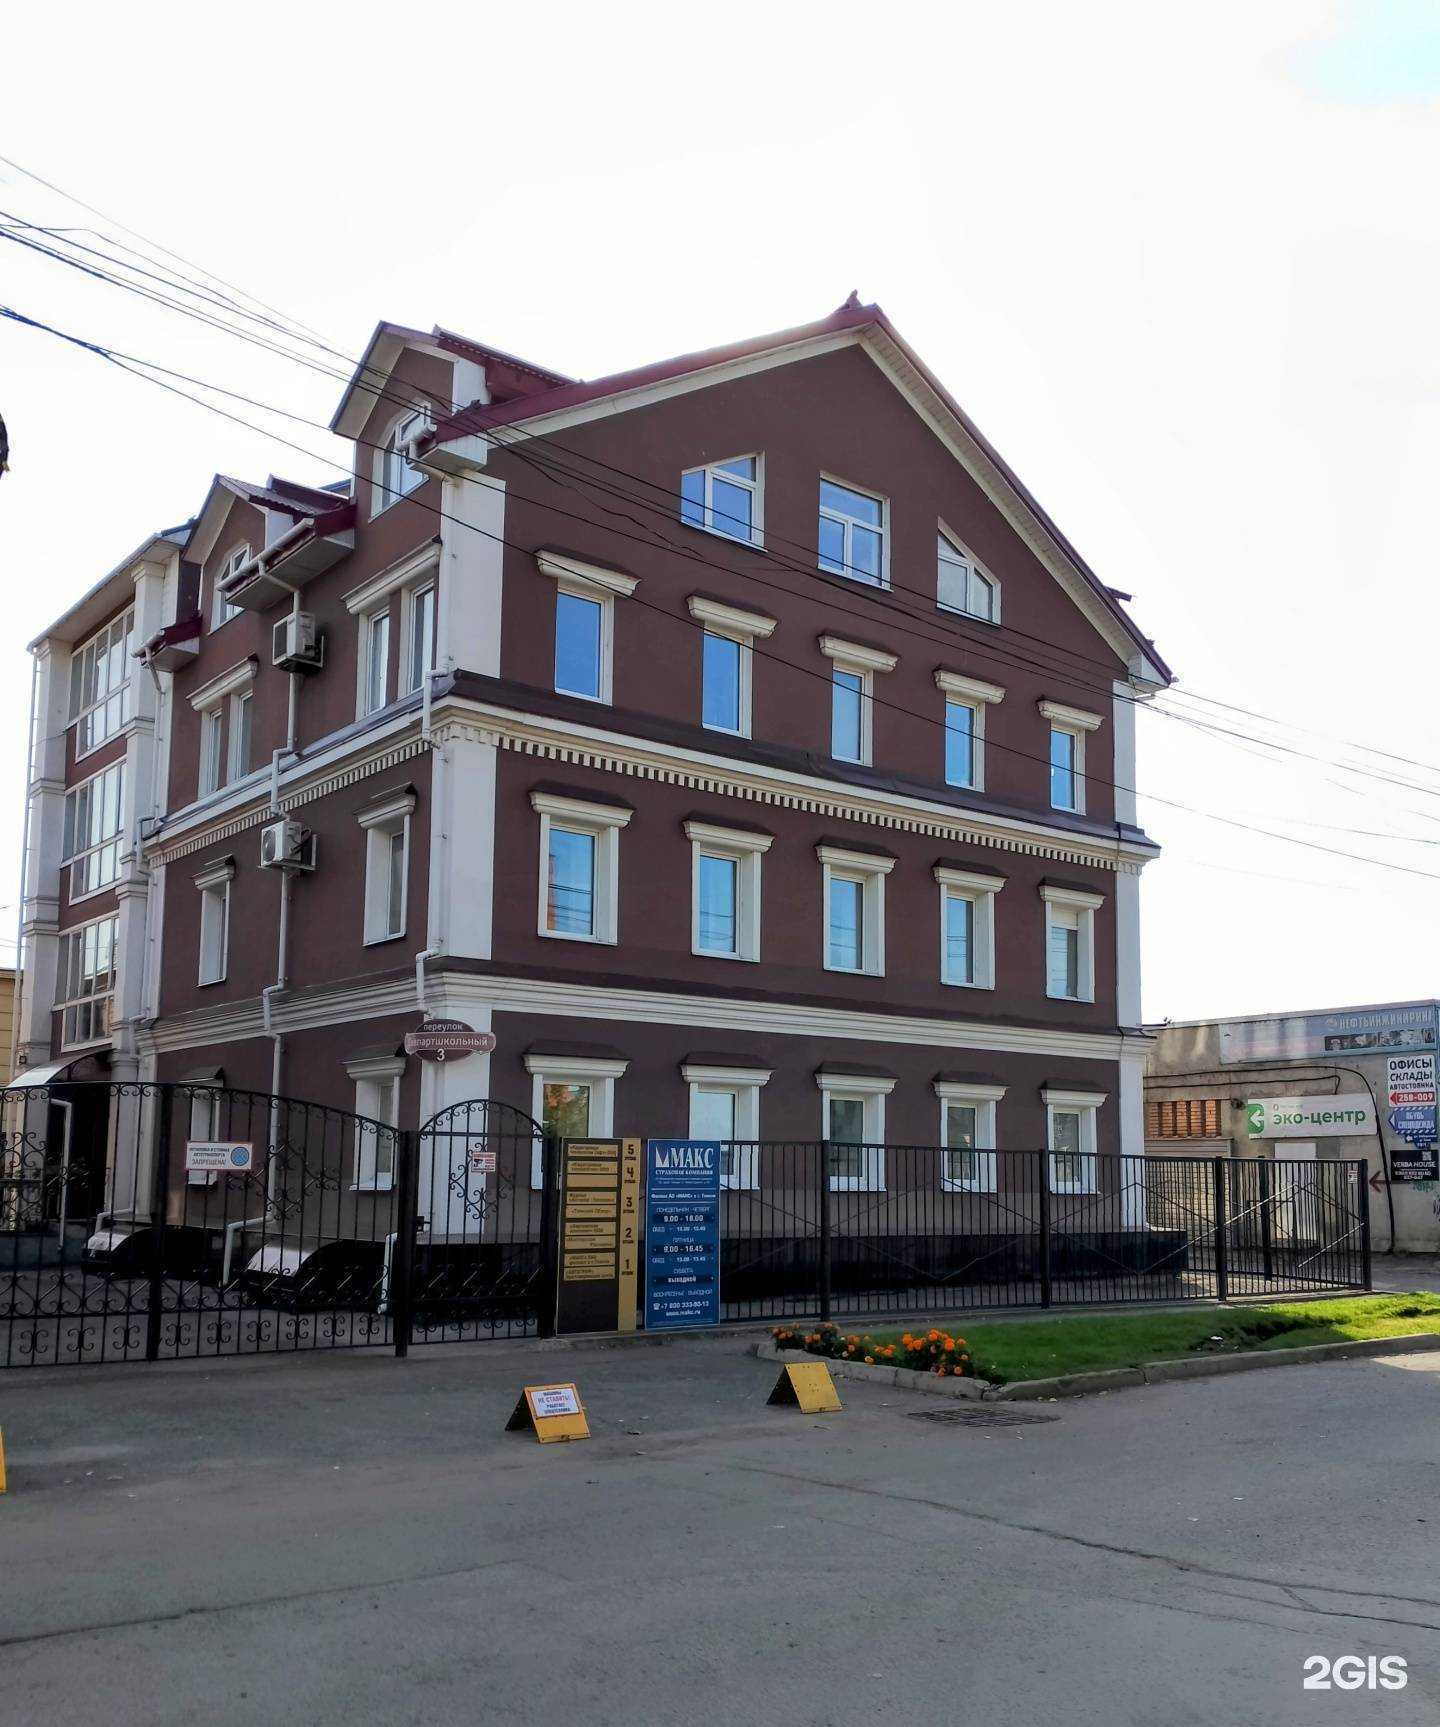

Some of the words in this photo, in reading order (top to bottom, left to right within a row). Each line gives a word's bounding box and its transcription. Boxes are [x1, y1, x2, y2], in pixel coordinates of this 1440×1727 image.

[423, 1023, 463, 1031] переулок
[436, 1048, 445, 1060] 3
[1389, 1058, 1432, 1070] ОФИСЫ
[1390, 1071, 1433, 1082] СКЛАДЫ
[627, 1144, 635, 1155] 5
[670, 1147, 714, 1168] МАКС
[627, 1167, 635, 1178] 4
[626, 1196, 633, 1208] 3
[625, 1227, 633, 1238] 2
[625, 1259, 630, 1270] 1
